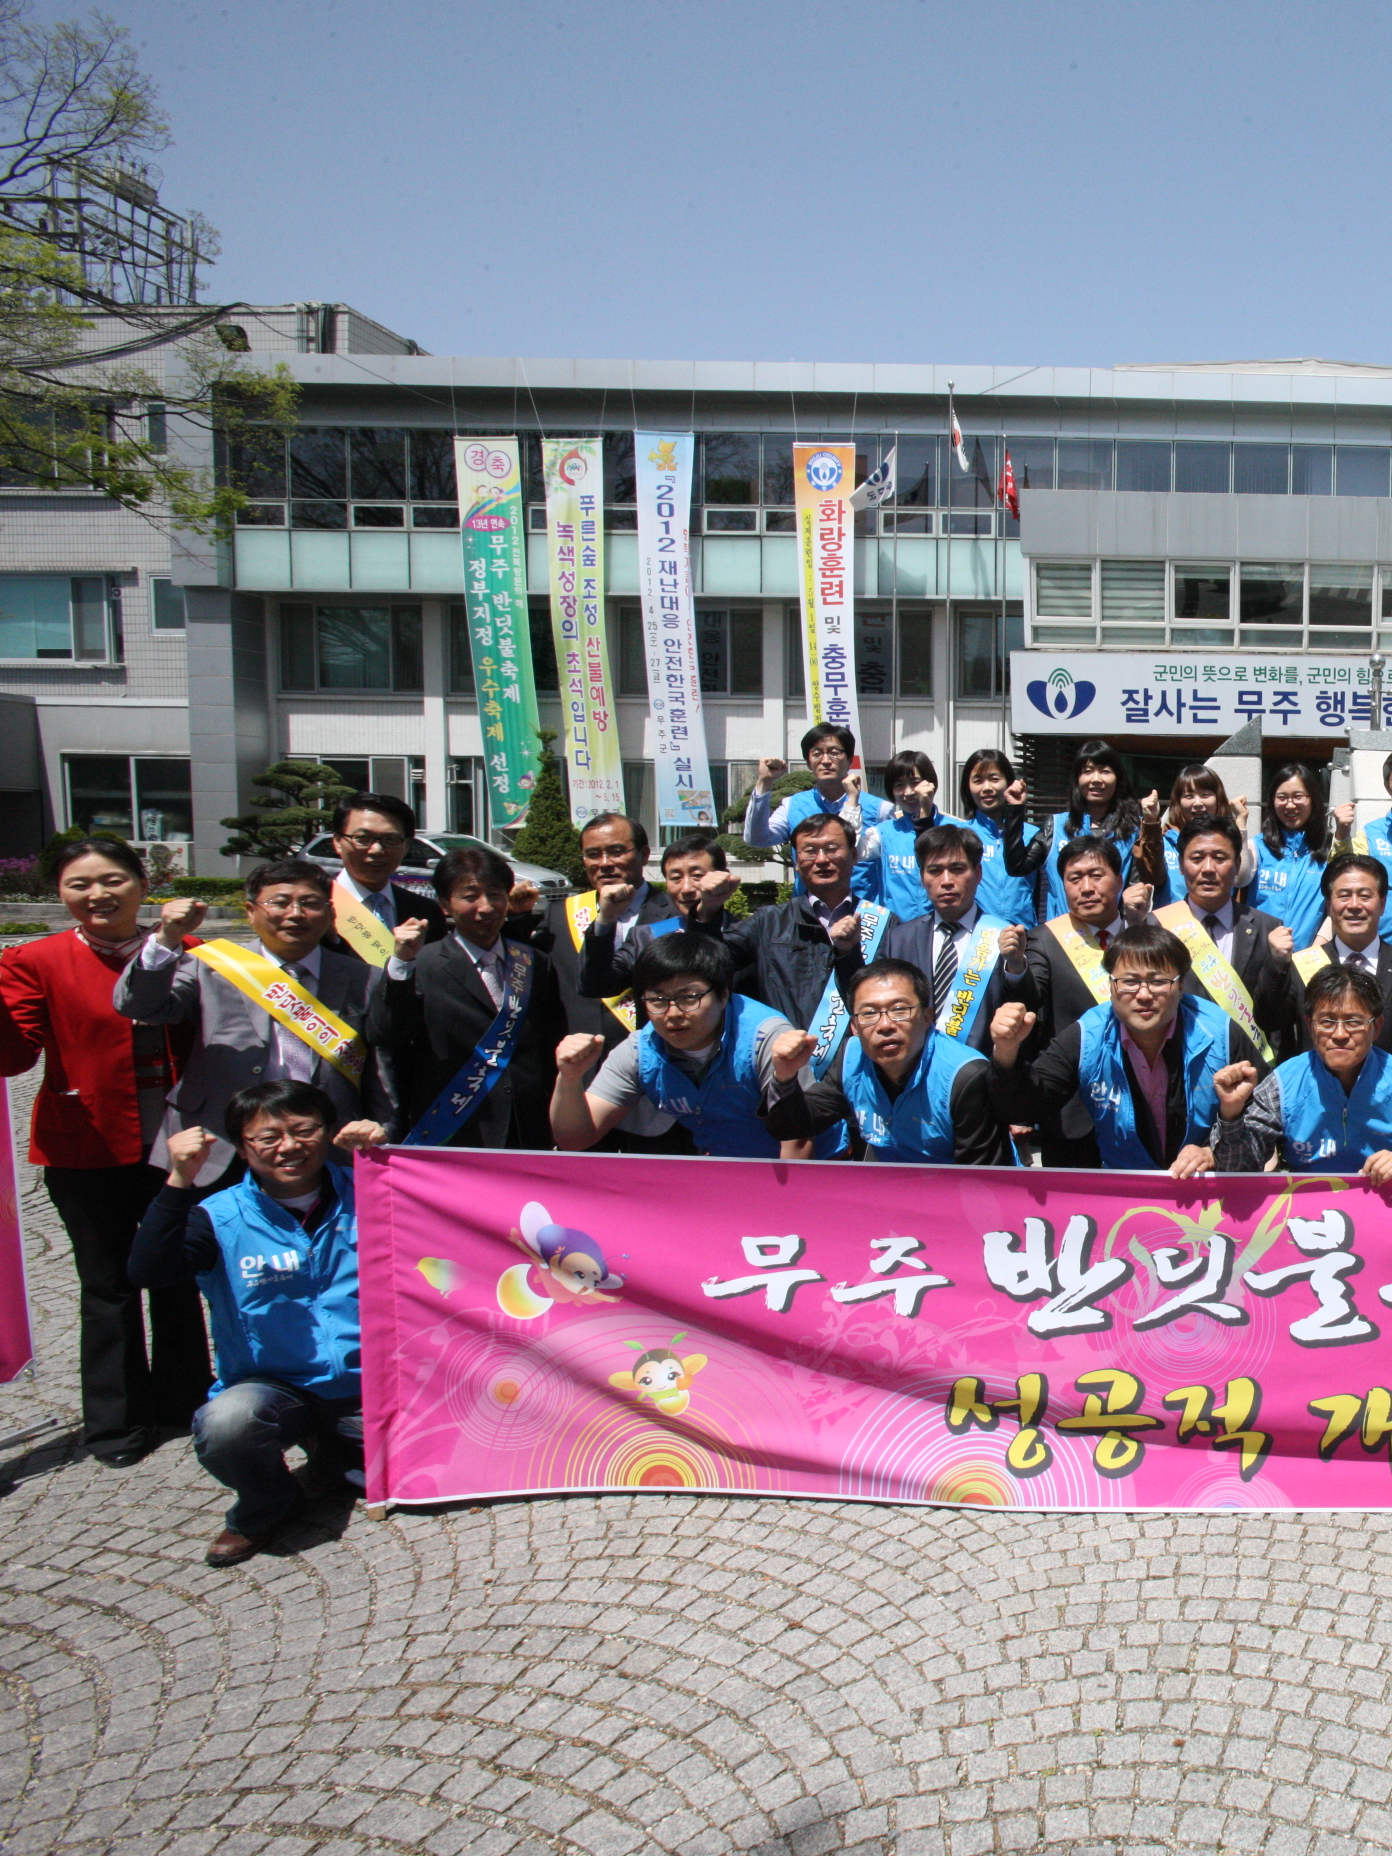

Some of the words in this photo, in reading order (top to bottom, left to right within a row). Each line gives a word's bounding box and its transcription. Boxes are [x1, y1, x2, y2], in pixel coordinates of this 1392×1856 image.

[471, 518, 489, 530] 13년
[490, 518, 506, 530] 연속
[509, 505, 520, 546] 2012
[579, 494, 597, 567] 푸른숲
[488, 534, 510, 580] 무주
[818, 499, 847, 606] 화랑훈련
[468, 557, 493, 647] 정부지정
[556, 520, 580, 642] 녹색성장의
[582, 578, 598, 627] 조성
[492, 590, 521, 705] 반딧불축제
[824, 615, 842, 635] 및
[586, 635, 609, 733] 산불예방
[658, 559, 680, 629] 재난대응
[673, 756, 694, 789] 실시
[821, 643, 851, 732] 충무훈
[1152, 664, 1198, 683] 군민의
[1201, 664, 1249, 683] 뜻으로
[1253, 665, 1303, 686] 변화를,
[1306, 667, 1352, 686] 군민의
[478, 655, 505, 743] 우수축제
[566, 651, 592, 771] 초석입니다
[1119, 687, 1222, 725] 잘사는
[1233, 689, 1302, 726] 무주
[656, 715, 668, 754] 무주군
[490, 751, 510, 794] 선정
[888, 854, 916, 869] 안내
[944, 989, 975, 1038] 반딧불
[1292, 1138, 1337, 1159] 안내
[239, 1249, 300, 1279] 안내
[701, 1234, 954, 1320] 무주
[945, 1367, 1274, 1483] 성공적
